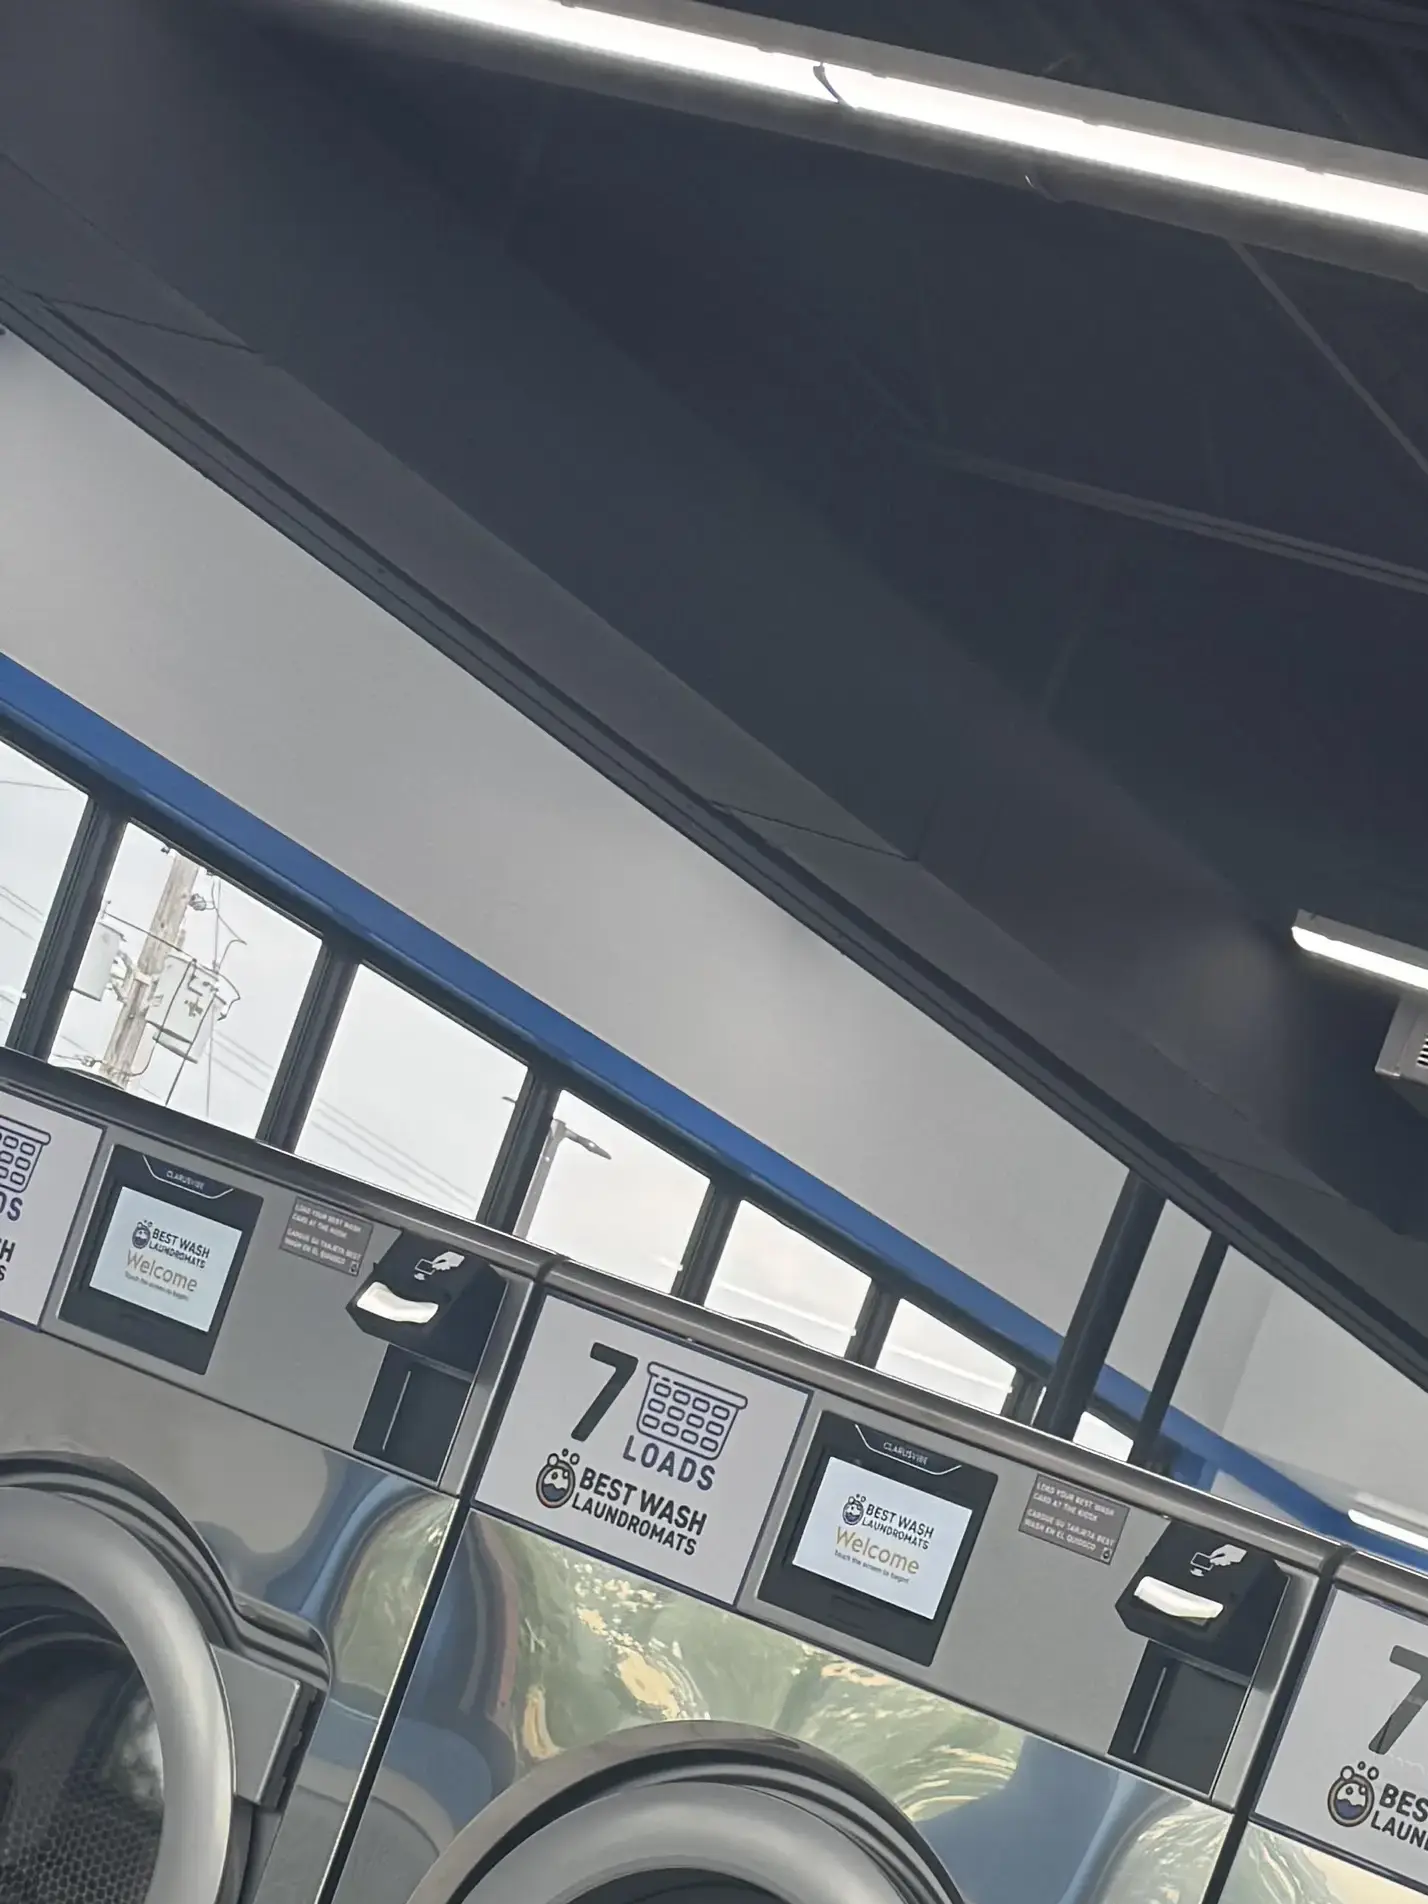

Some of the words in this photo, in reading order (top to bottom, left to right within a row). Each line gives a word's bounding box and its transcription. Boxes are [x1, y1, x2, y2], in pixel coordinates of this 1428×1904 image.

[153, 1229, 179, 1245] BEST
[180, 1238, 210, 1258] WASH
[127, 1249, 197, 1291] Welcome
[571, 1342, 639, 1442] 7
[623, 1435, 715, 1491] LOADS
[572, 1493, 697, 1555] LAUNDROMATS
[579, 1467, 637, 1506] BEST
[639, 1490, 708, 1536] WASH
[866, 1504, 897, 1523] BEST
[899, 1516, 934, 1539] WASH
[835, 1526, 919, 1575] Welcome
[862, 1517, 930, 1550] LAUNDROMATS
